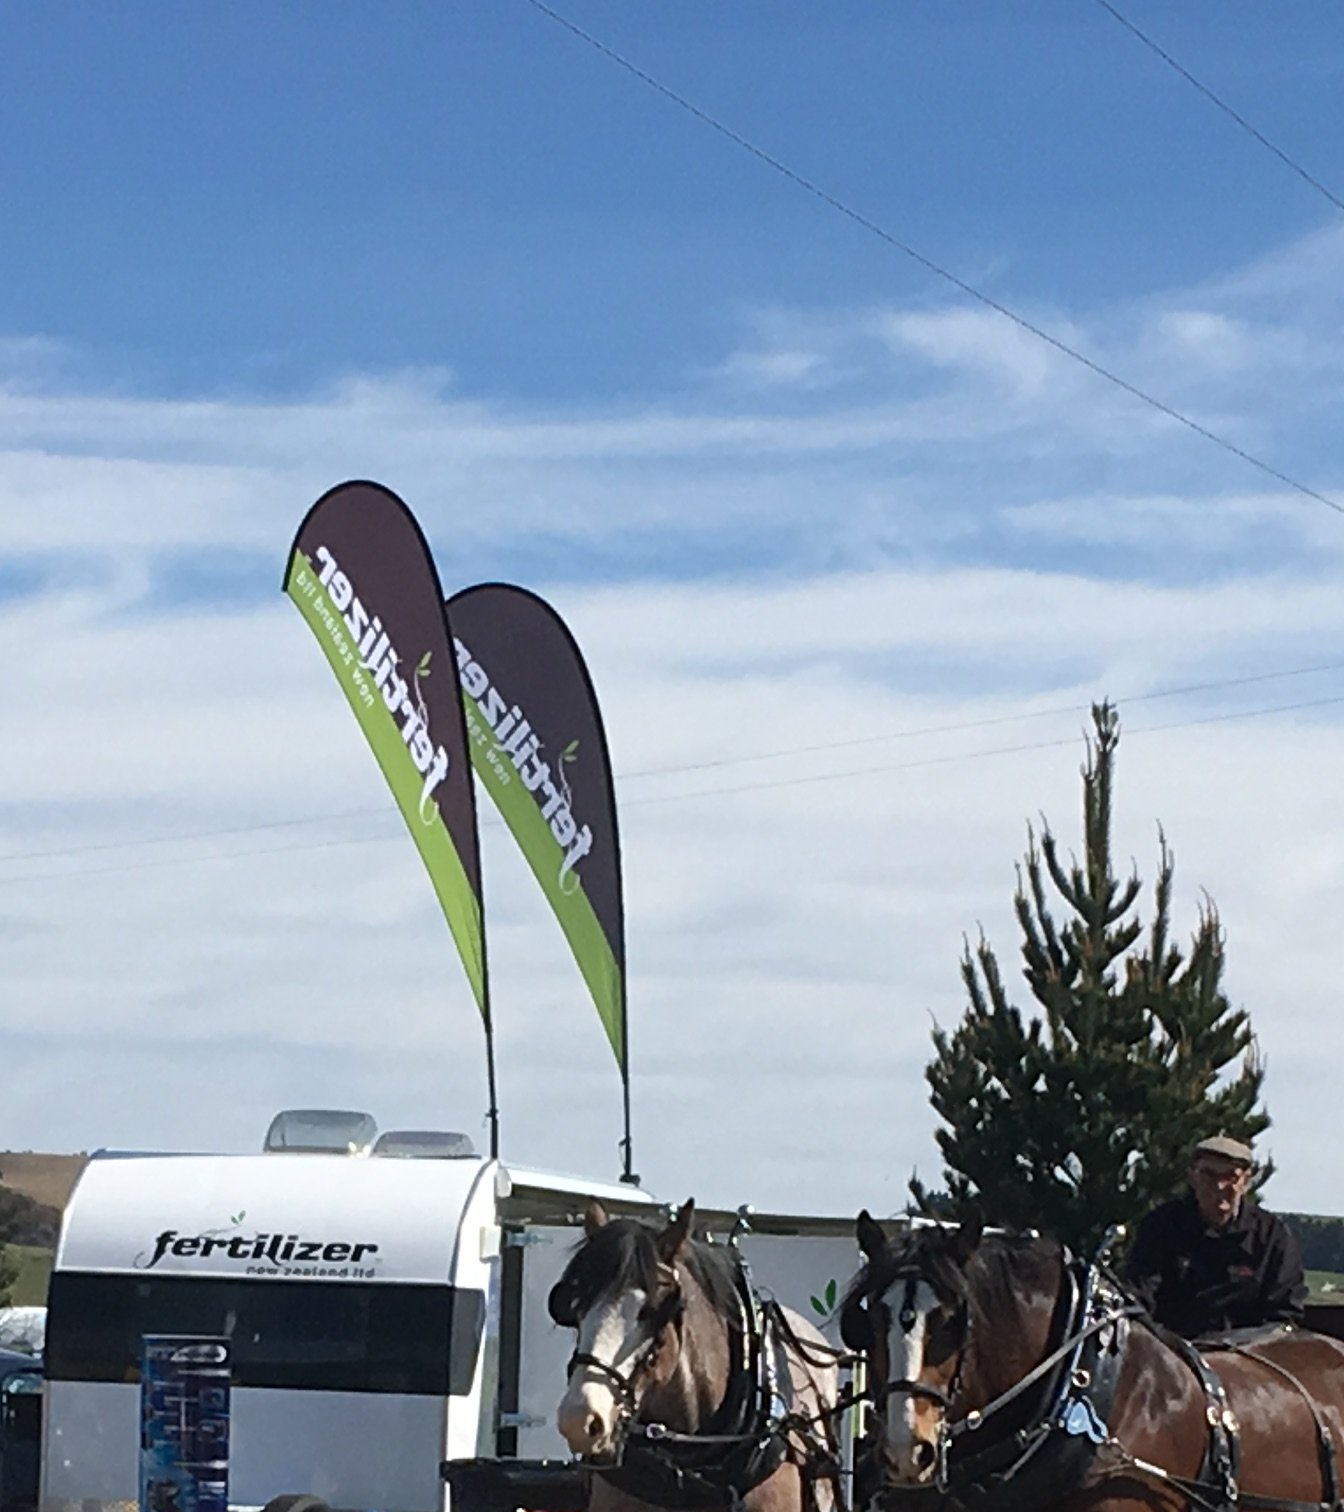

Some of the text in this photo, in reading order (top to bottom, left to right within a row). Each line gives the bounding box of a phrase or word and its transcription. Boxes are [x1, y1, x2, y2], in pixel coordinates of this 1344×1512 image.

[134, 1230, 379, 1269] fertilizer
[246, 1266, 376, 1279] new zealand ltd
